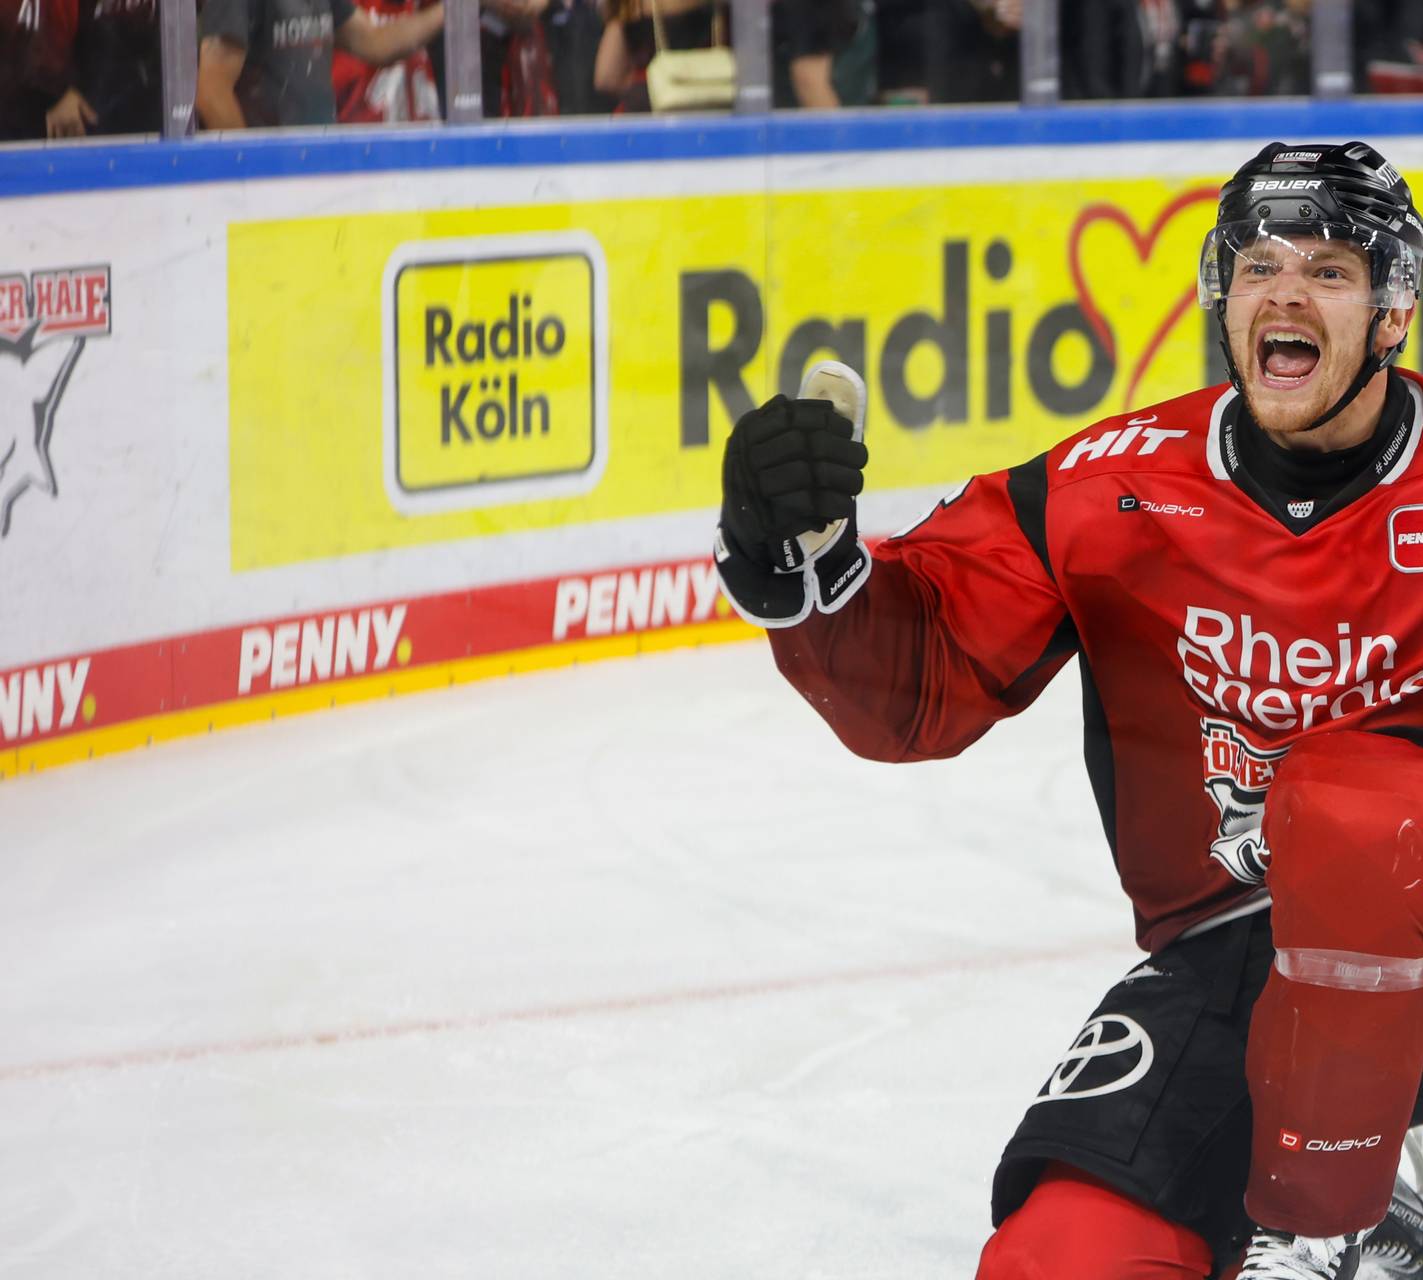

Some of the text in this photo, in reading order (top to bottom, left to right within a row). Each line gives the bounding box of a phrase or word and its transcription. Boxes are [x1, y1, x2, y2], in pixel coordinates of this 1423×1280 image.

[1250, 180, 1322, 192] BAUER
[36, 273, 107, 324] HAIE
[423, 294, 566, 368] Radio
[680, 235, 1058, 451] Radio
[441, 377, 551, 447] Köln
[830, 558, 863, 596] BAUER
[1185, 605, 1397, 688] Rhein
